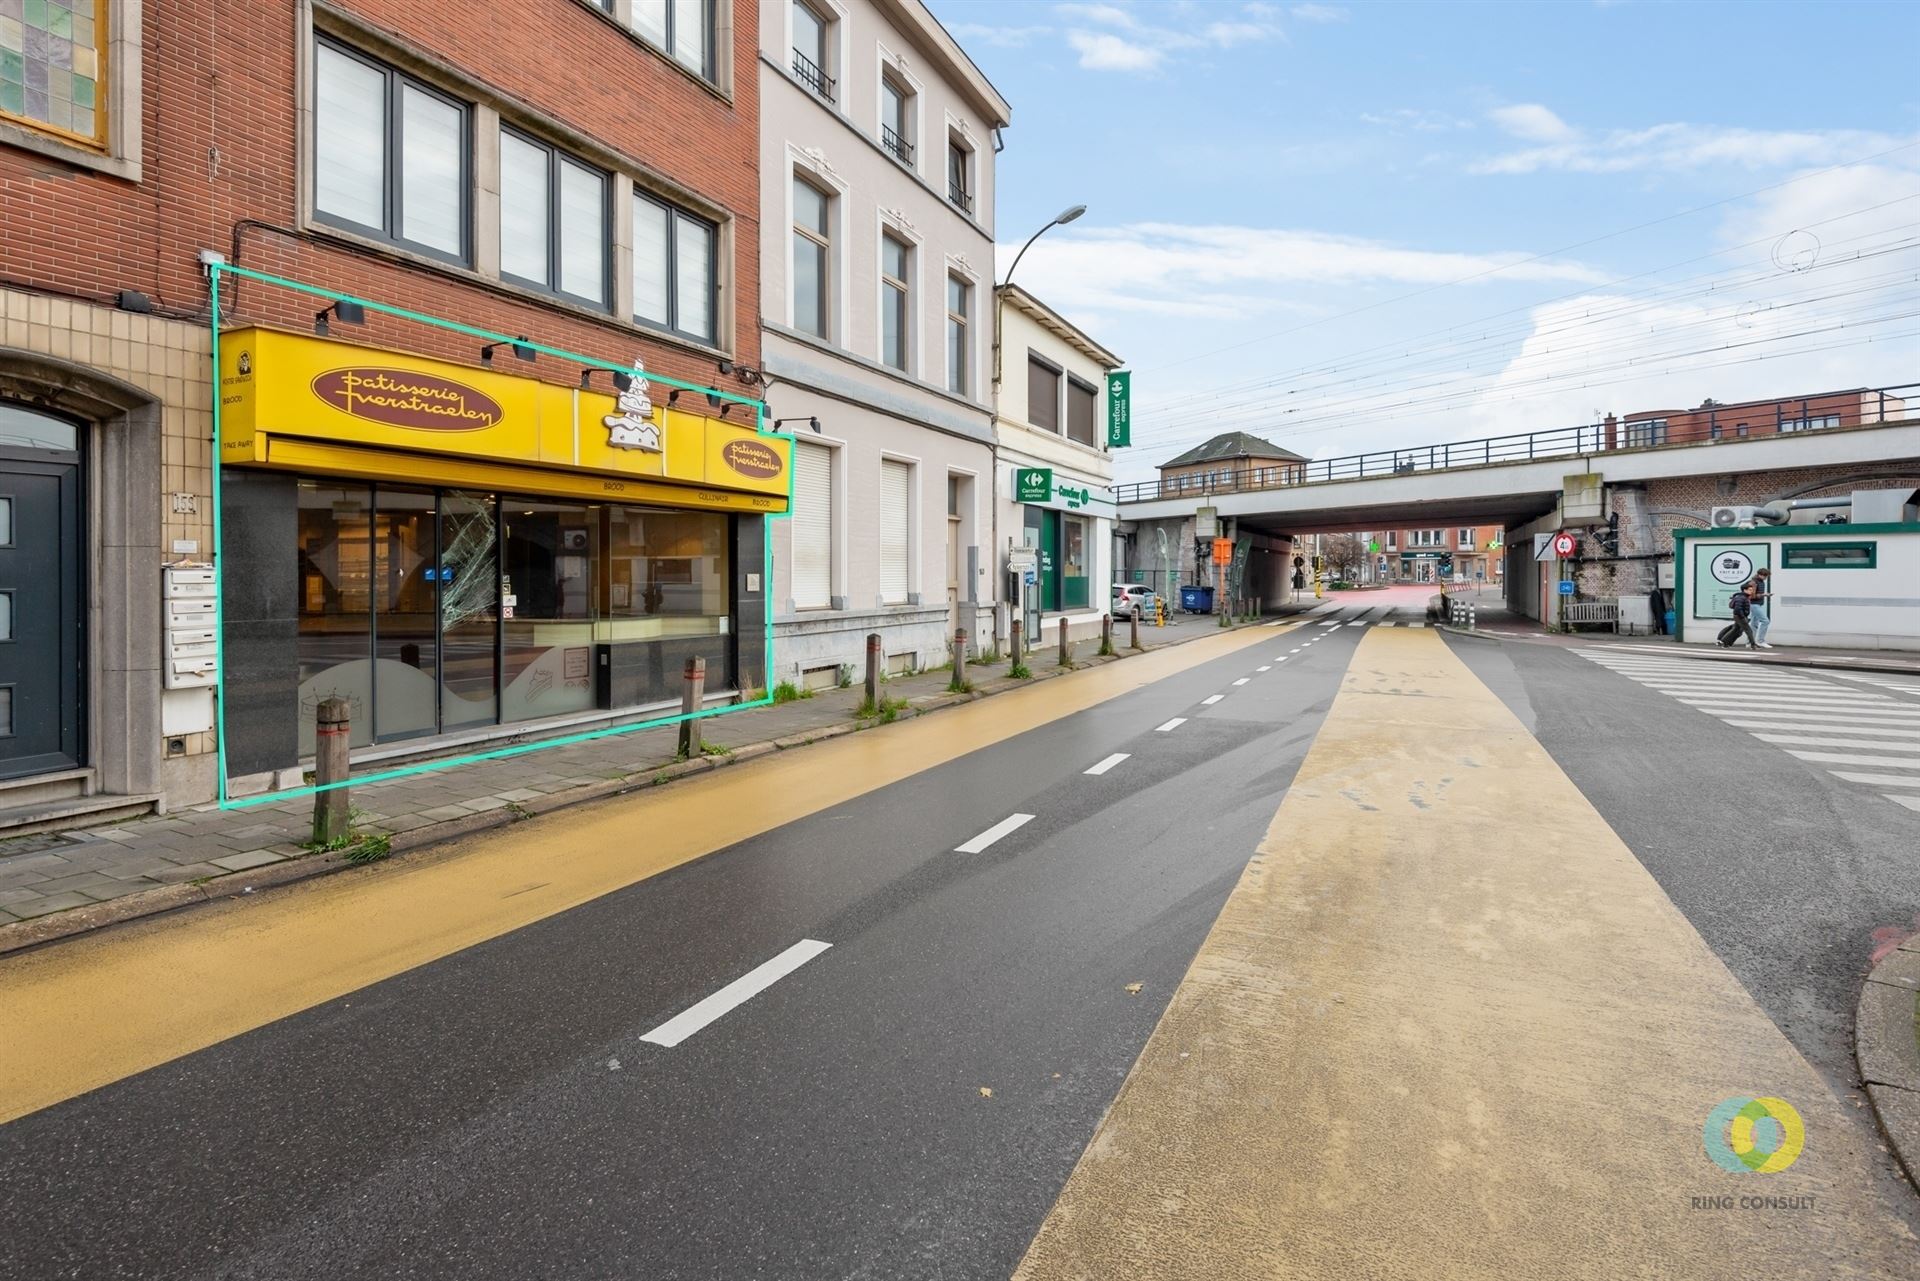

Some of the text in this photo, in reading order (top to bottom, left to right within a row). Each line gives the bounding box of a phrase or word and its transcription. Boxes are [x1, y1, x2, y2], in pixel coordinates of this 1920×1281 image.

[341, 371, 462, 405] patisserie
[1112, 399, 1121, 440] Carrefour
[603, 481, 625, 492] BROOD
[1058, 484, 1081, 500] Carrefour
